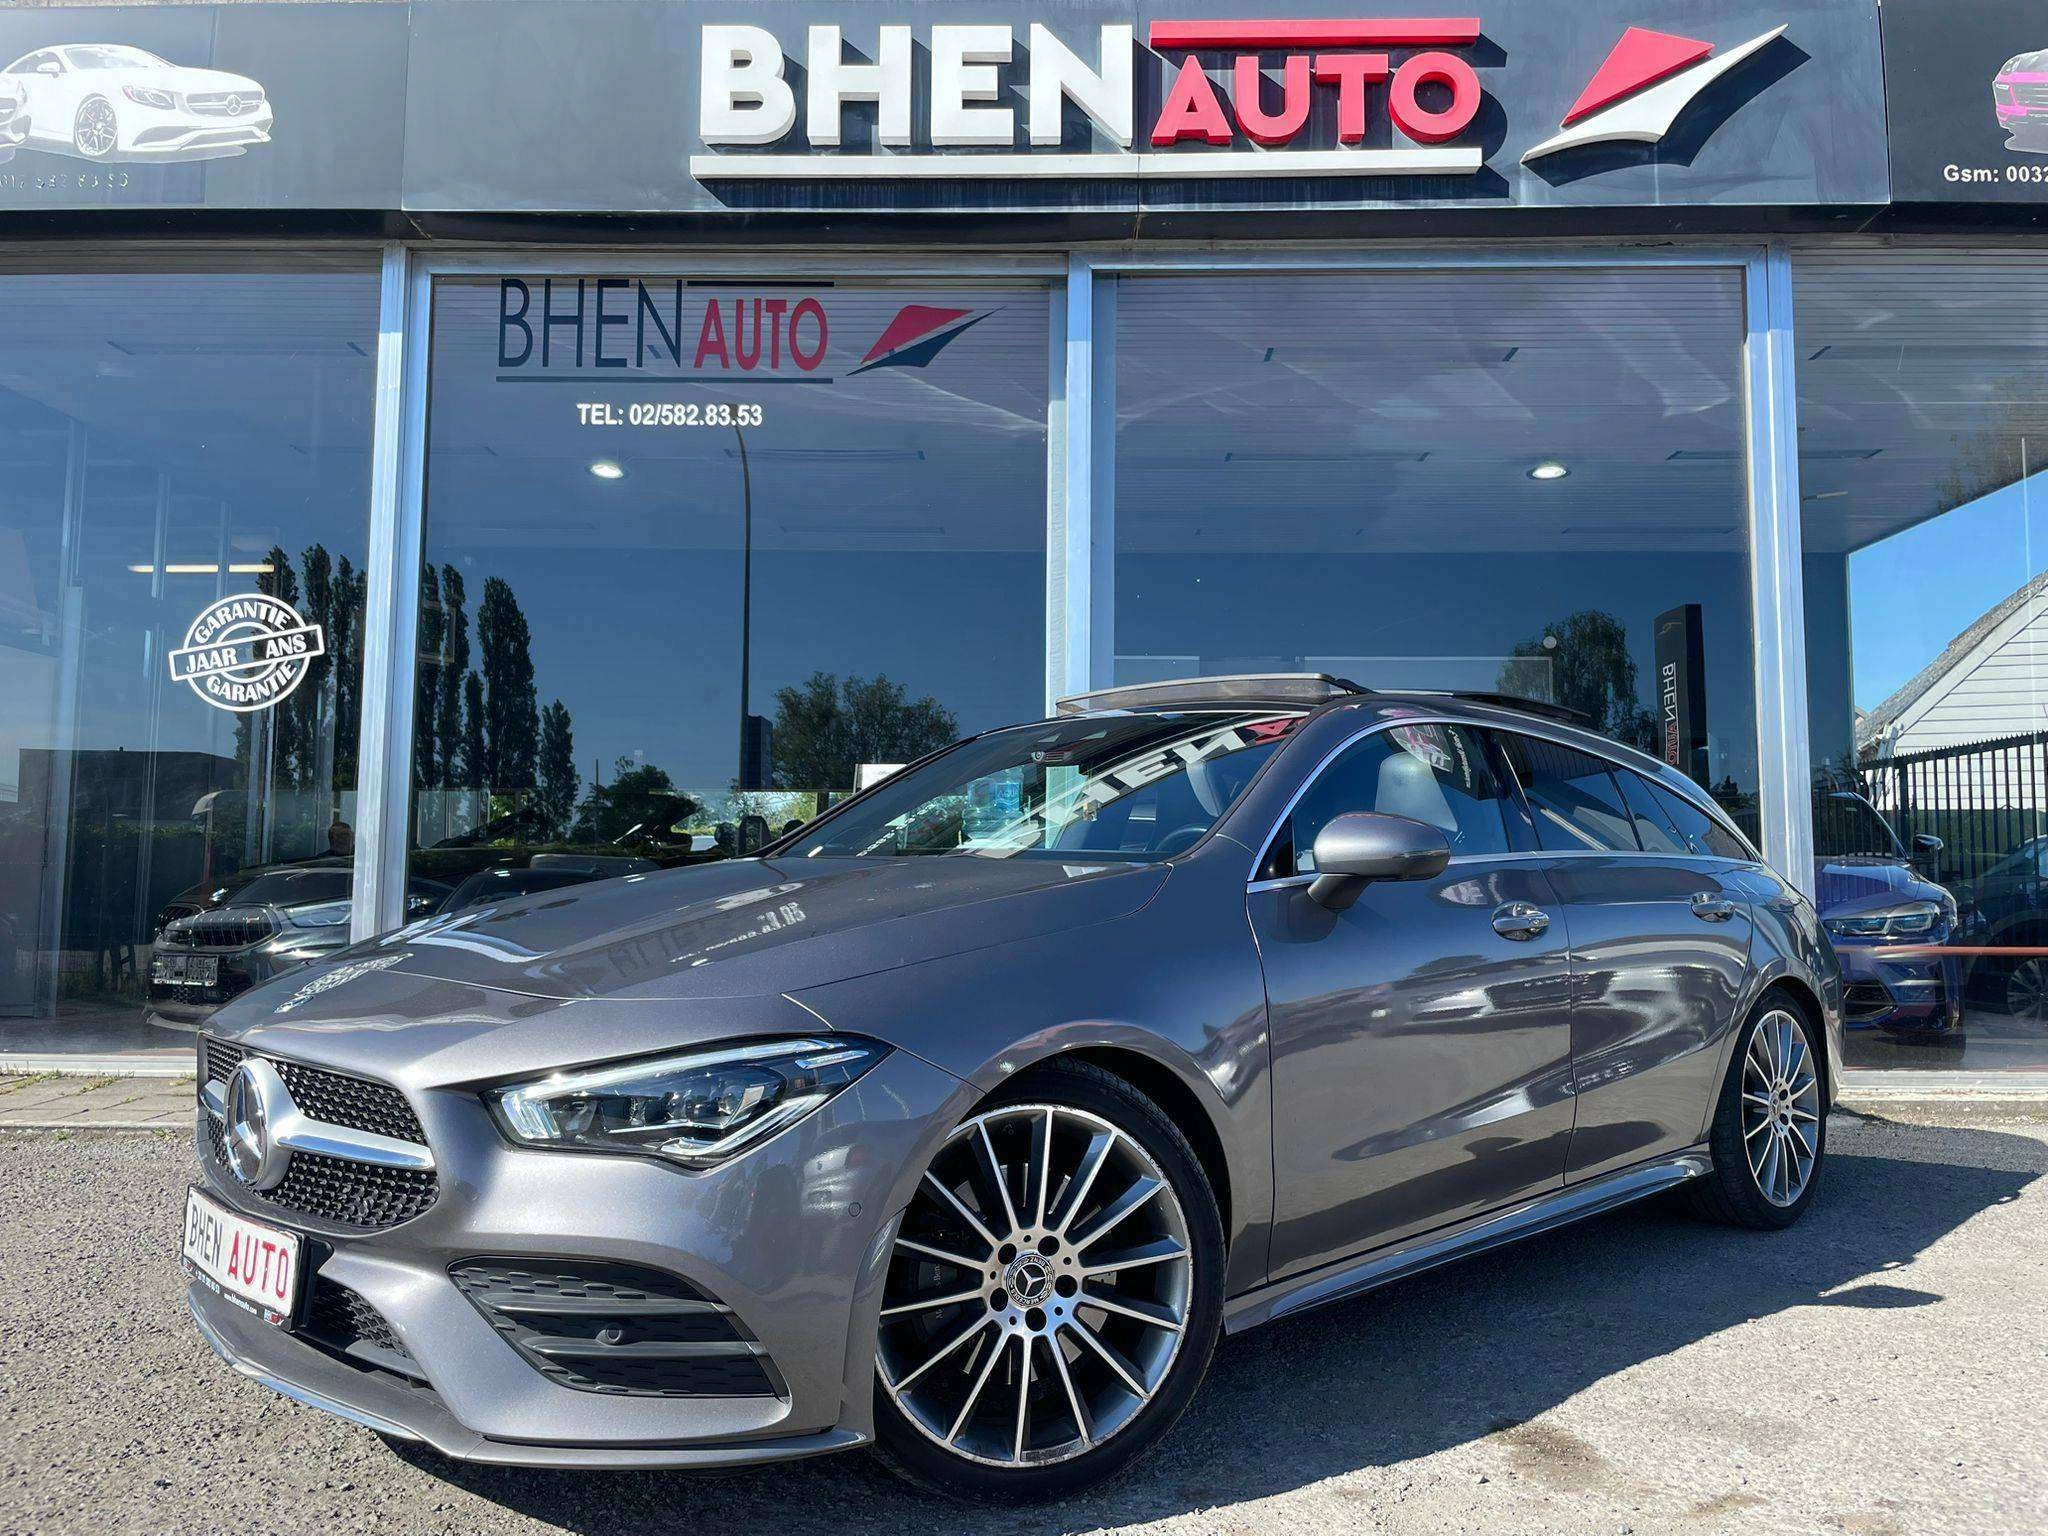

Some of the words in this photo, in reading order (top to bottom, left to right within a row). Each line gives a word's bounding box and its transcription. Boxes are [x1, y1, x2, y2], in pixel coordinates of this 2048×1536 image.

[700, 25, 1133, 147] BHEN
[1151, 52, 1481, 146] AUTO
[1943, 164, 2000, 183] Gsm:
[499, 278, 683, 368] BHEN
[693, 297, 829, 371] AUTO
[576, 403, 625, 426] TEL:
[629, 403, 763, 427] 02/582.83.53
[194, 601, 292, 644] GARANTIE
[186, 647, 238, 674] JAAR
[265, 634, 307, 659] ANS
[206, 661, 298, 703] GARANTIE
[188, 1204, 223, 1269] BHEN
[227, 1230, 289, 1300] AUTO
